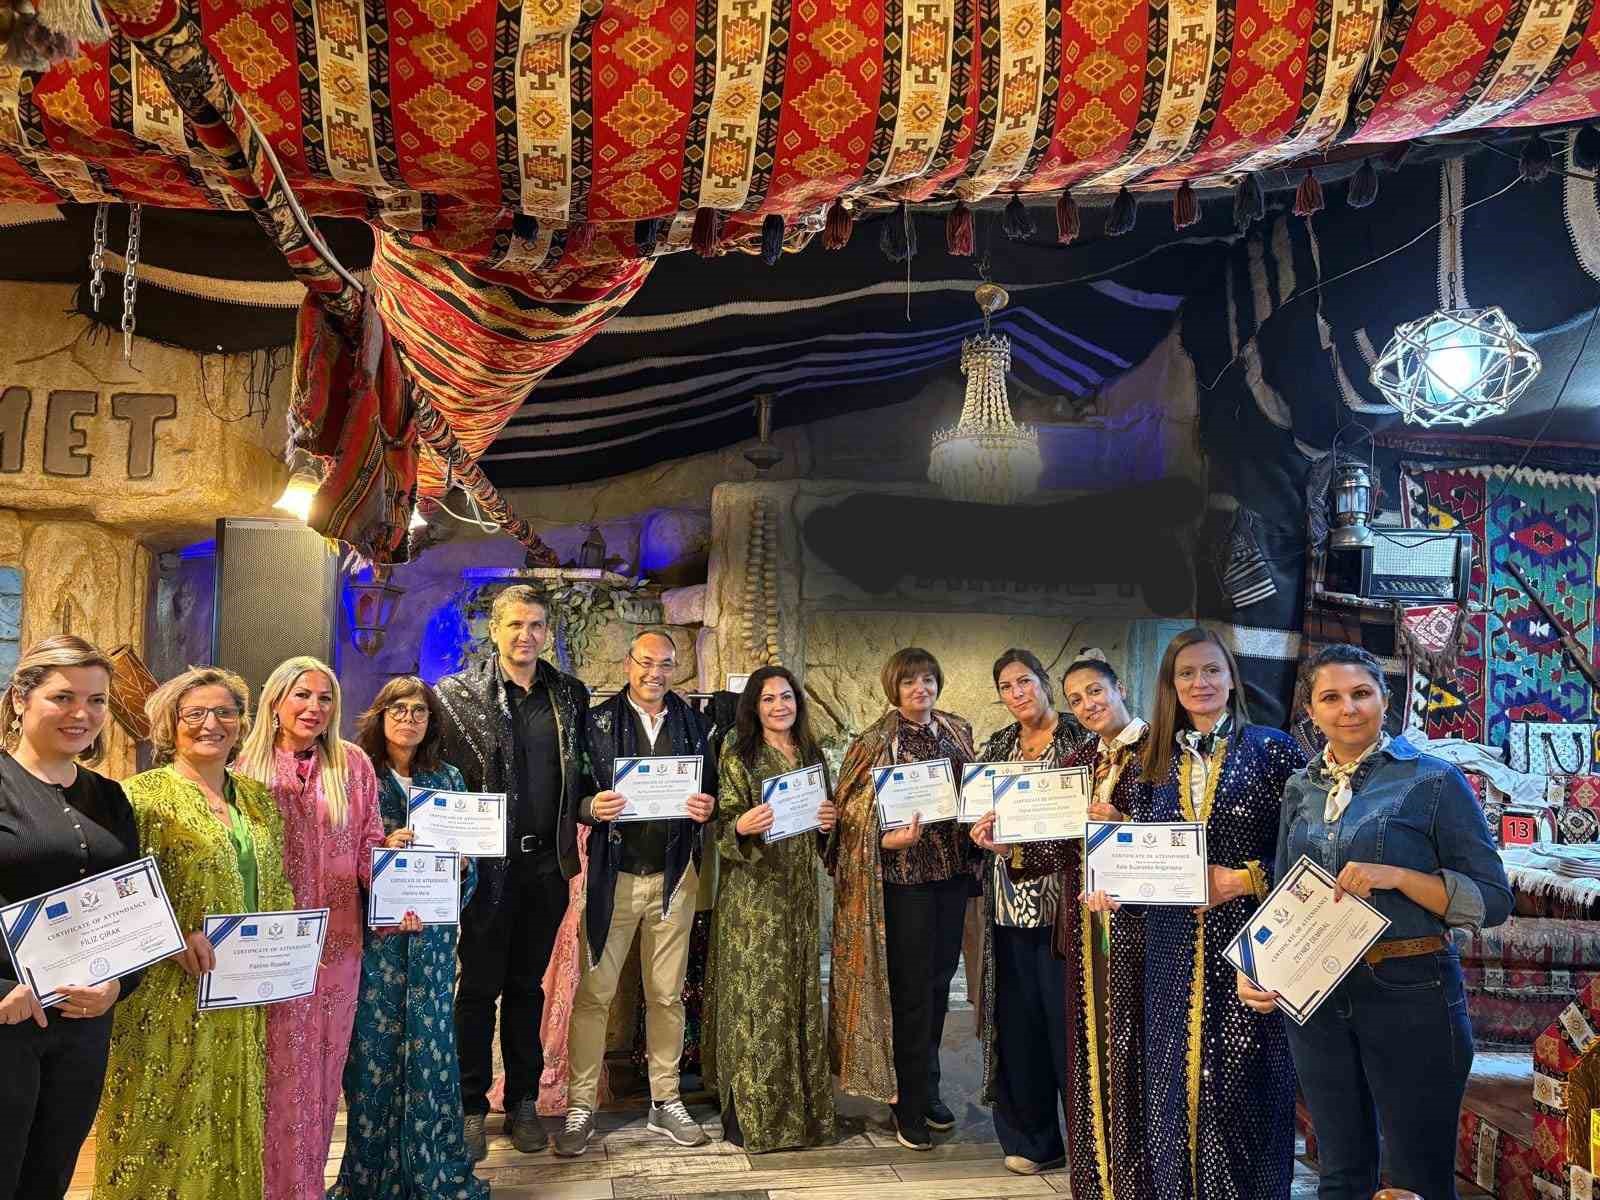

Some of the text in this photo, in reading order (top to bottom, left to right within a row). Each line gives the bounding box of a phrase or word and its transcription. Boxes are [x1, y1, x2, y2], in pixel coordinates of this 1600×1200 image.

[1508, 821, 1529, 838] 13
[47, 920, 91, 942] CERTIFICATE
[92, 917, 102, 926] OF
[103, 900, 148, 921] ATTENDANCE
